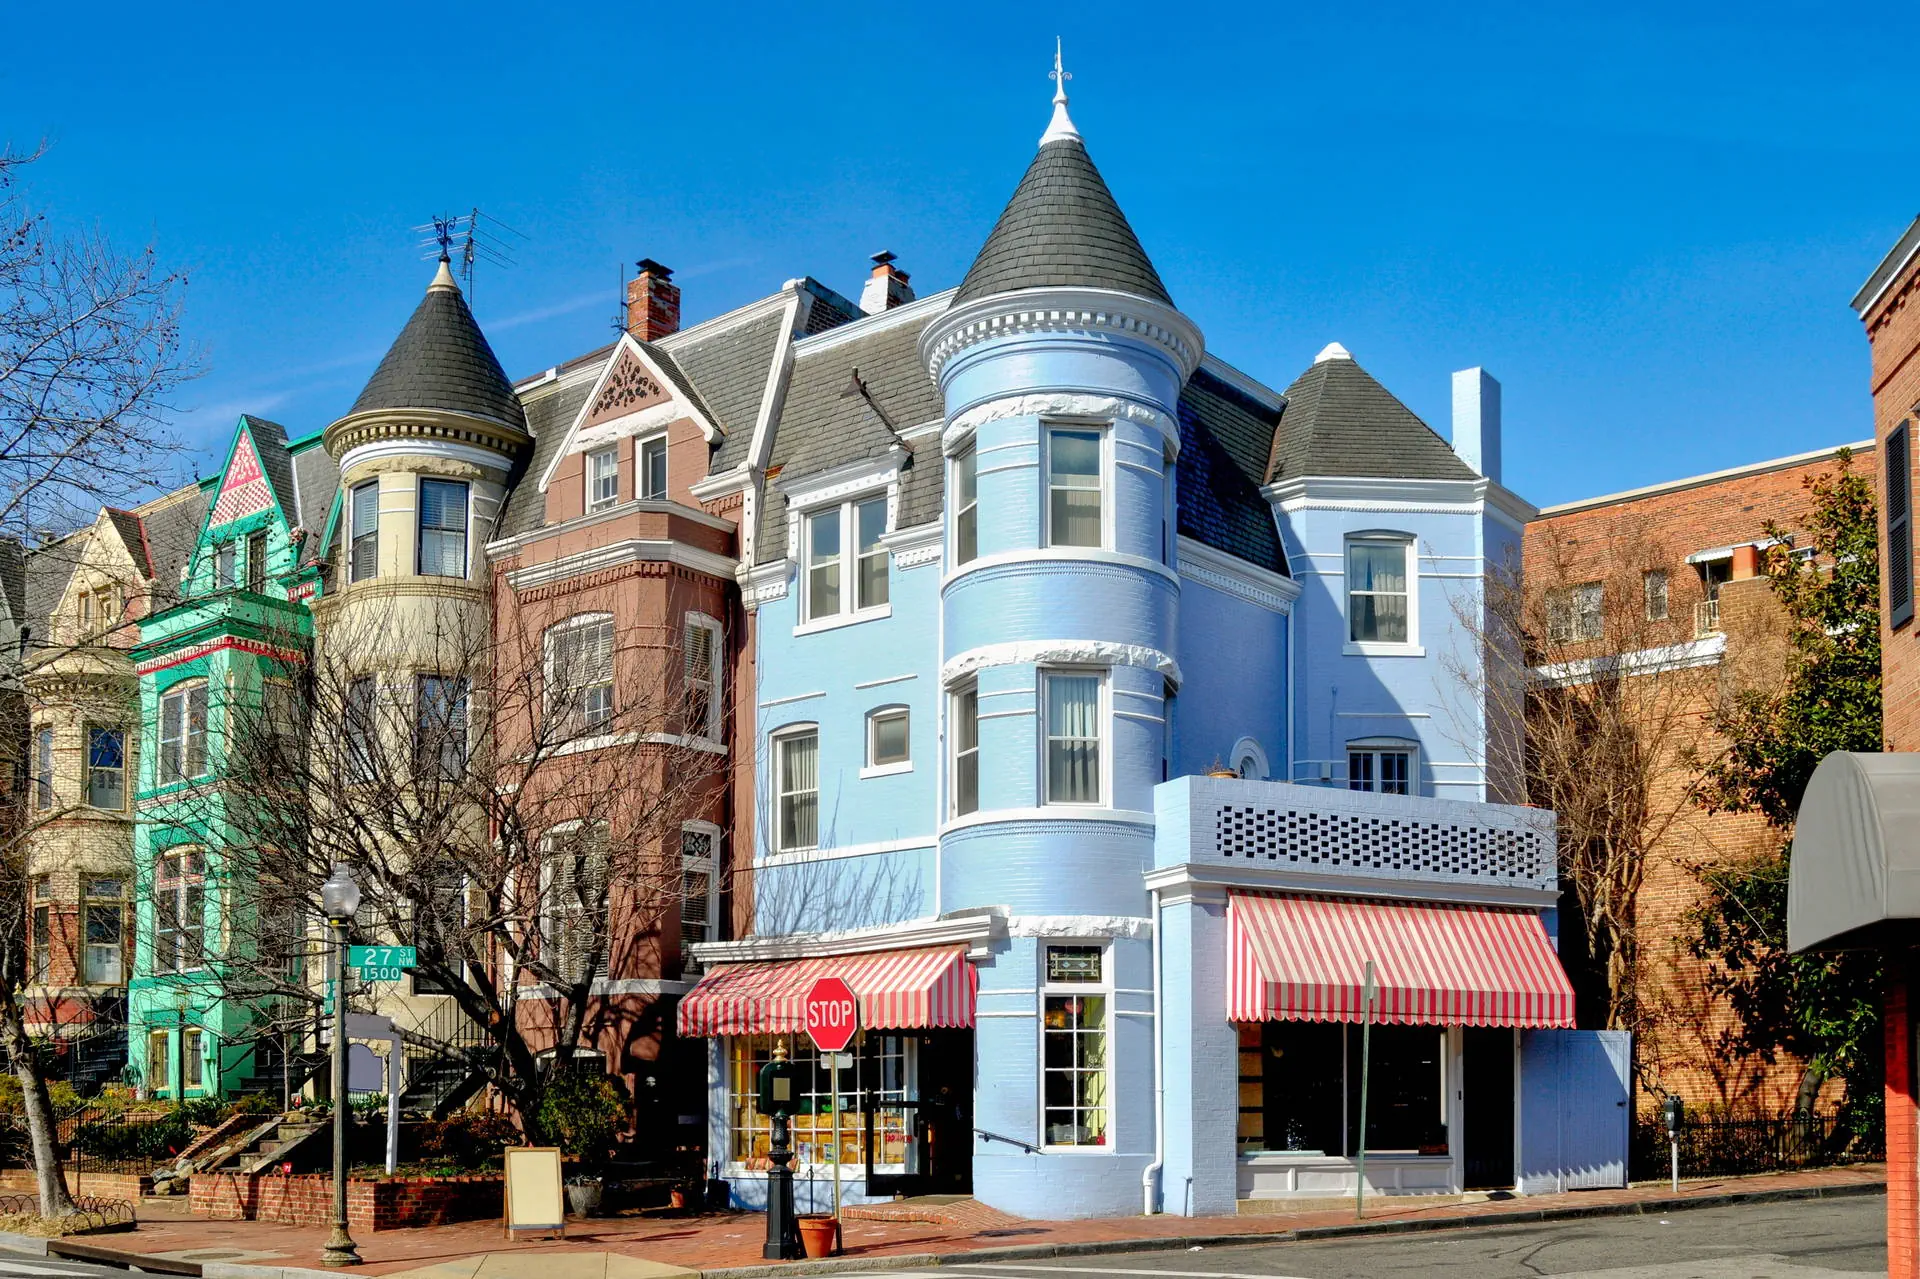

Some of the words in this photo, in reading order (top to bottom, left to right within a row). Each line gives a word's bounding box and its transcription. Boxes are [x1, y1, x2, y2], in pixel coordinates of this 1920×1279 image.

[365, 948, 392, 966] 27
[400, 949, 412, 957] ST
[399, 957, 413, 966] NW
[364, 967, 399, 979] 1500
[809, 1000, 852, 1027] STOP
